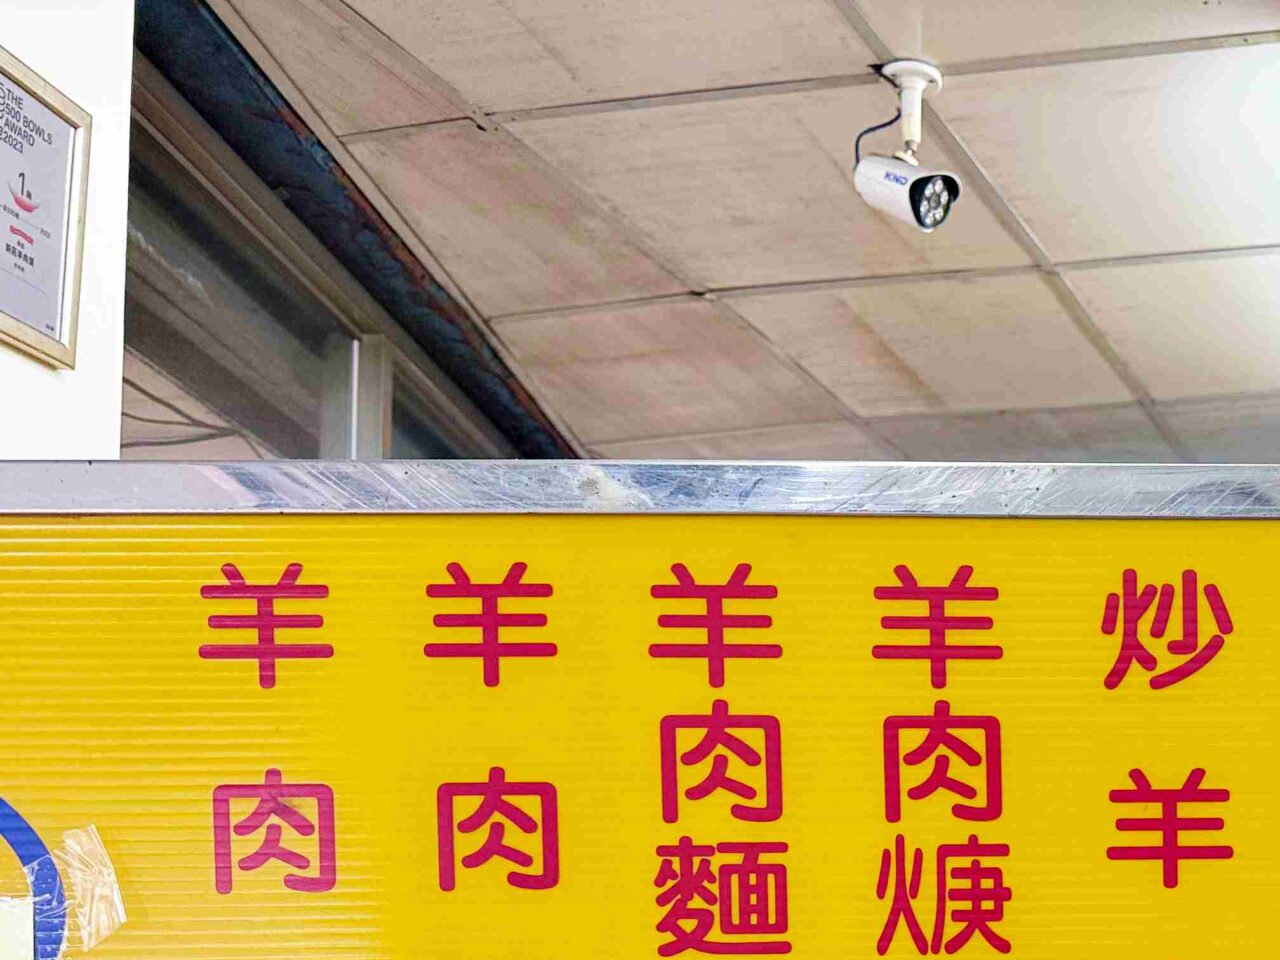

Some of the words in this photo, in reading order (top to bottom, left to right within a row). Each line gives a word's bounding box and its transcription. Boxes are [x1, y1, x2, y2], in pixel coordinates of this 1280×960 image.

[6, 88, 24, 111] THE
[4, 118, 35, 147] AWARD
[5, 103, 21, 123] 500
[23, 115, 53, 145] BOWLS
